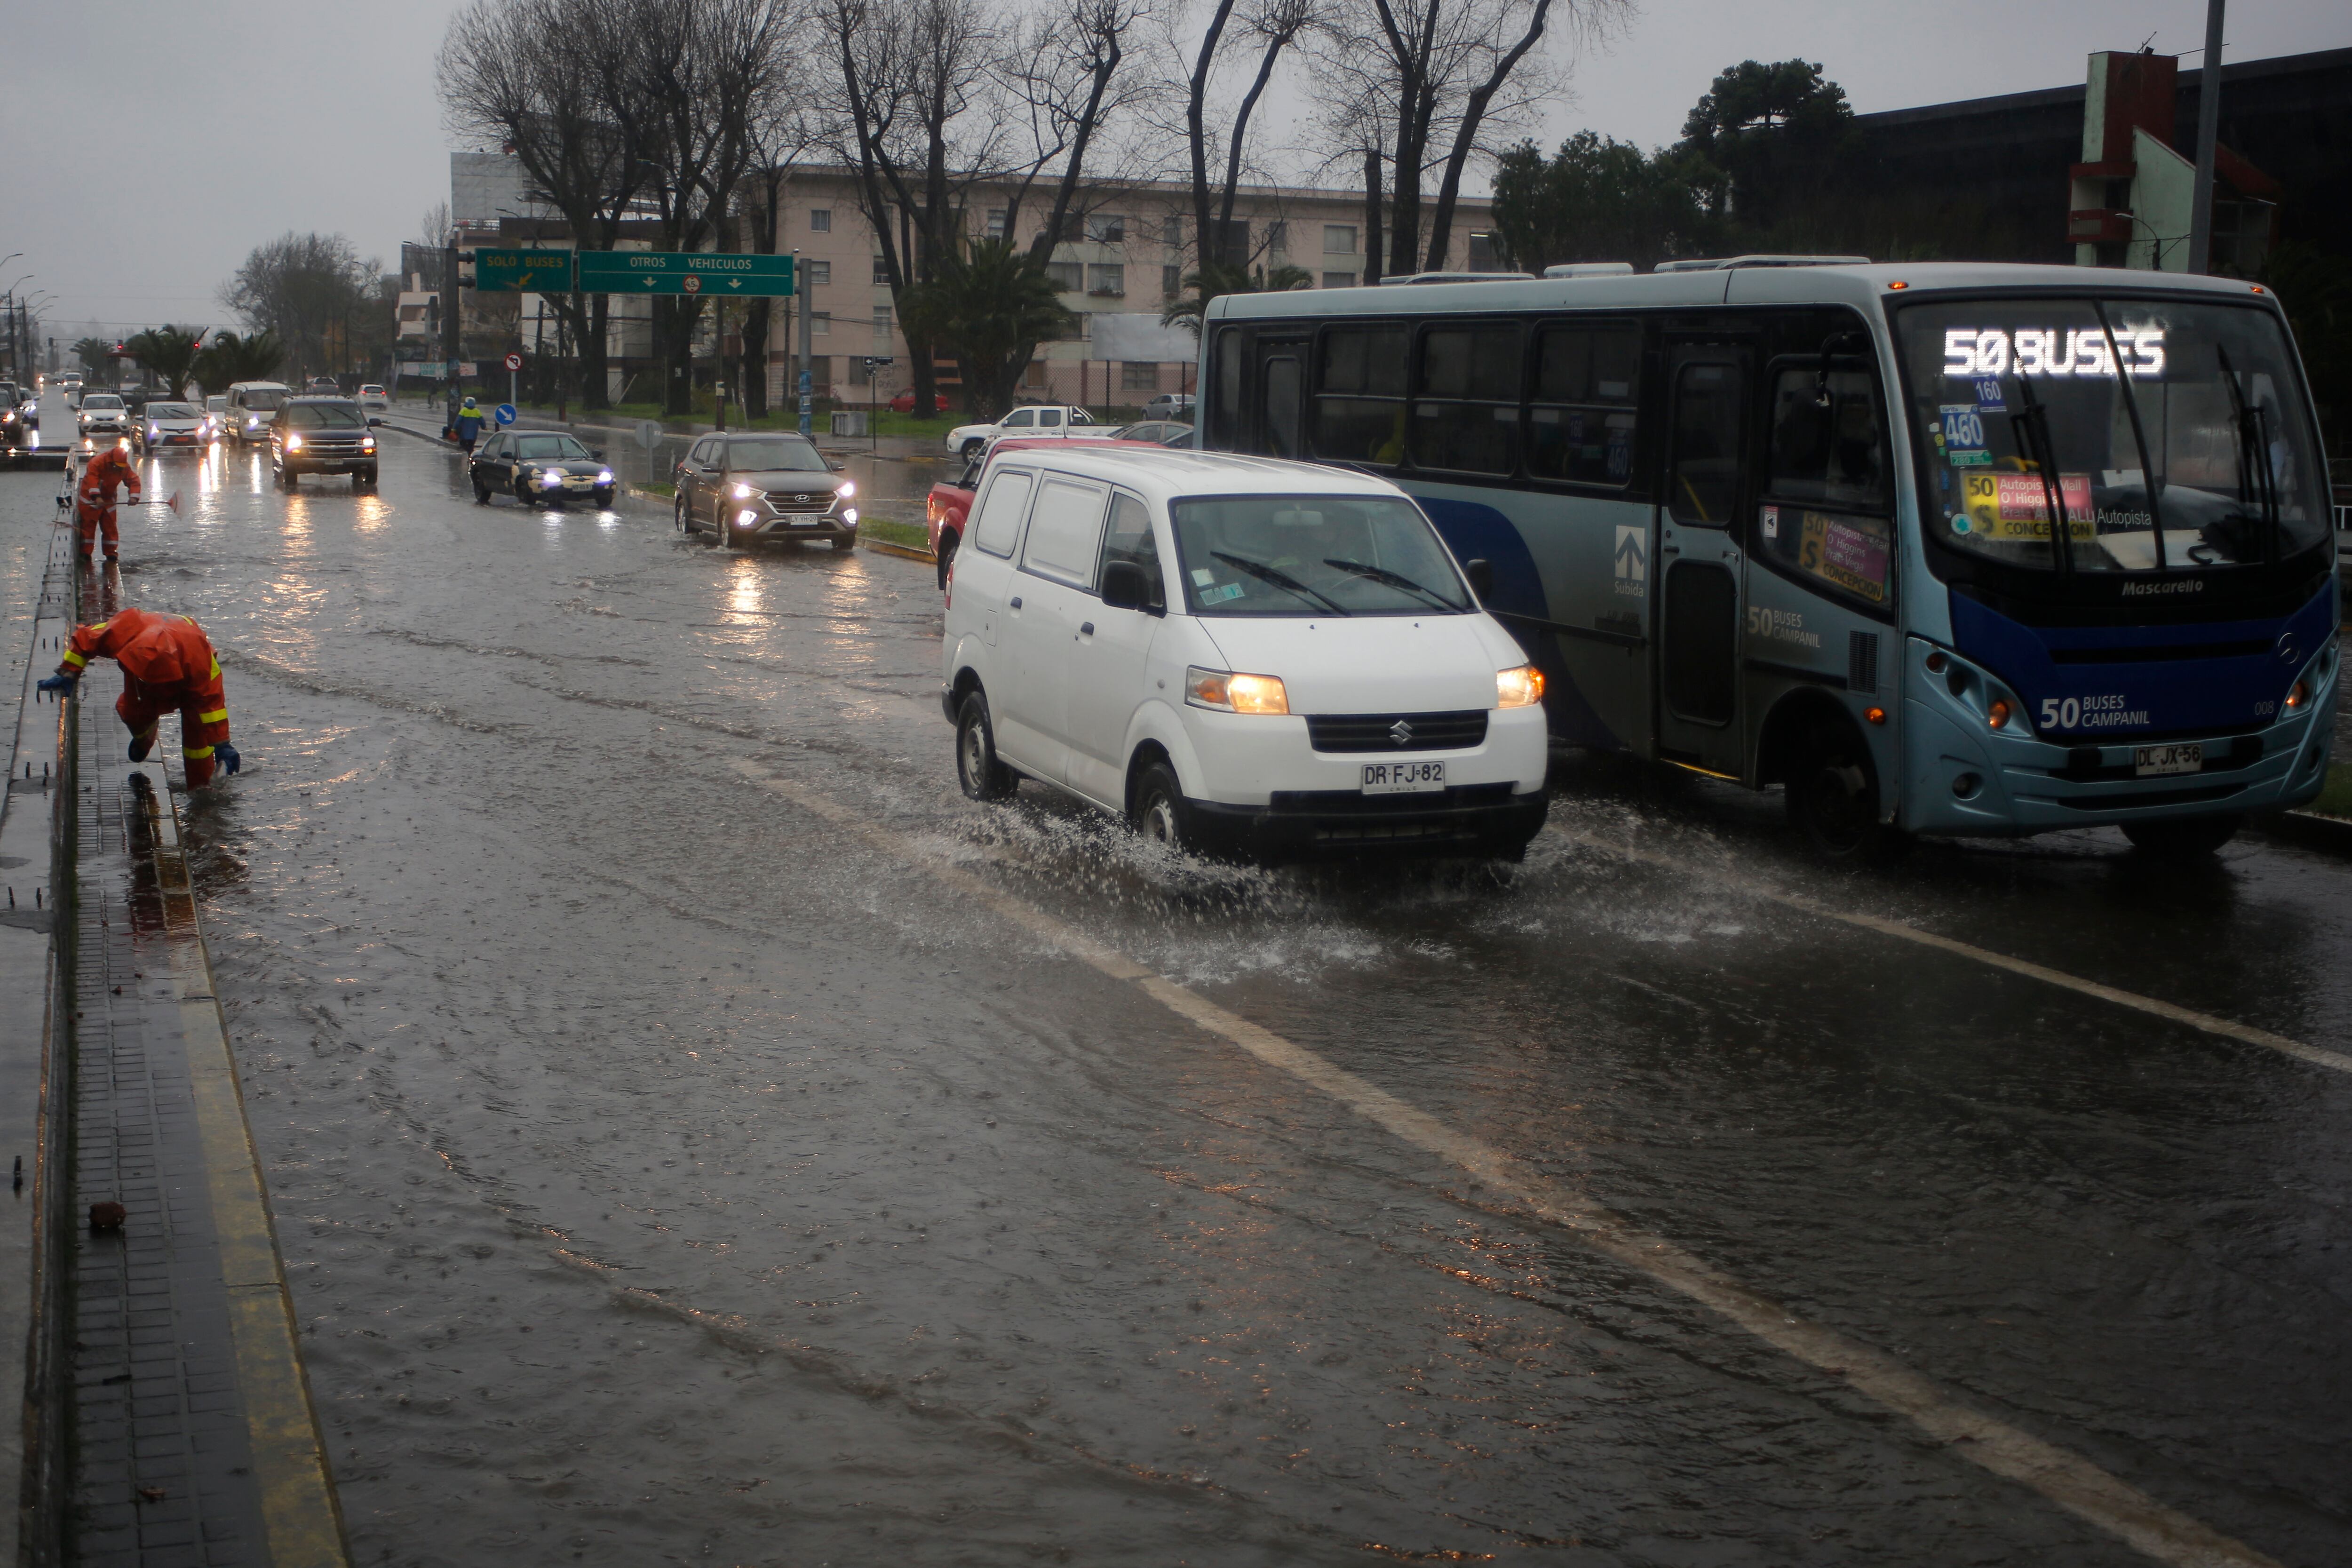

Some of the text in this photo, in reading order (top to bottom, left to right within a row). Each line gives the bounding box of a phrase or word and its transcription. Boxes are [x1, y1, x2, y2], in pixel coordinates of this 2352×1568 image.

[487, 256, 564, 268] SOLO BUSES
[630, 257, 752, 269] OTROS VEHICULOS
[2013, 331, 2165, 374] BUSES
[1976, 381, 2001, 400] 160
[1946, 414, 1983, 446] 460
[1969, 478, 1994, 496] 50
[1805, 512, 1823, 535] 50
[2097, 508, 2152, 528] Autopista
[2004, 523, 2090, 535] CONCEON
[1804, 540, 1818, 570] S
[1614, 581, 1644, 597] Subida
[1823, 564, 1882, 597] CONCEPCION
[2122, 580, 2203, 596] Mascarello
[1748, 606, 1772, 637] 50
[1774, 610, 1802, 628] BUSES
[1773, 626, 1820, 648] CAMPANIL
[2083, 695, 2125, 710] BUSES
[2255, 700, 2274, 715] 008
[2040, 698, 2079, 729] 50
[2082, 710, 2150, 727] CAMPANIL
